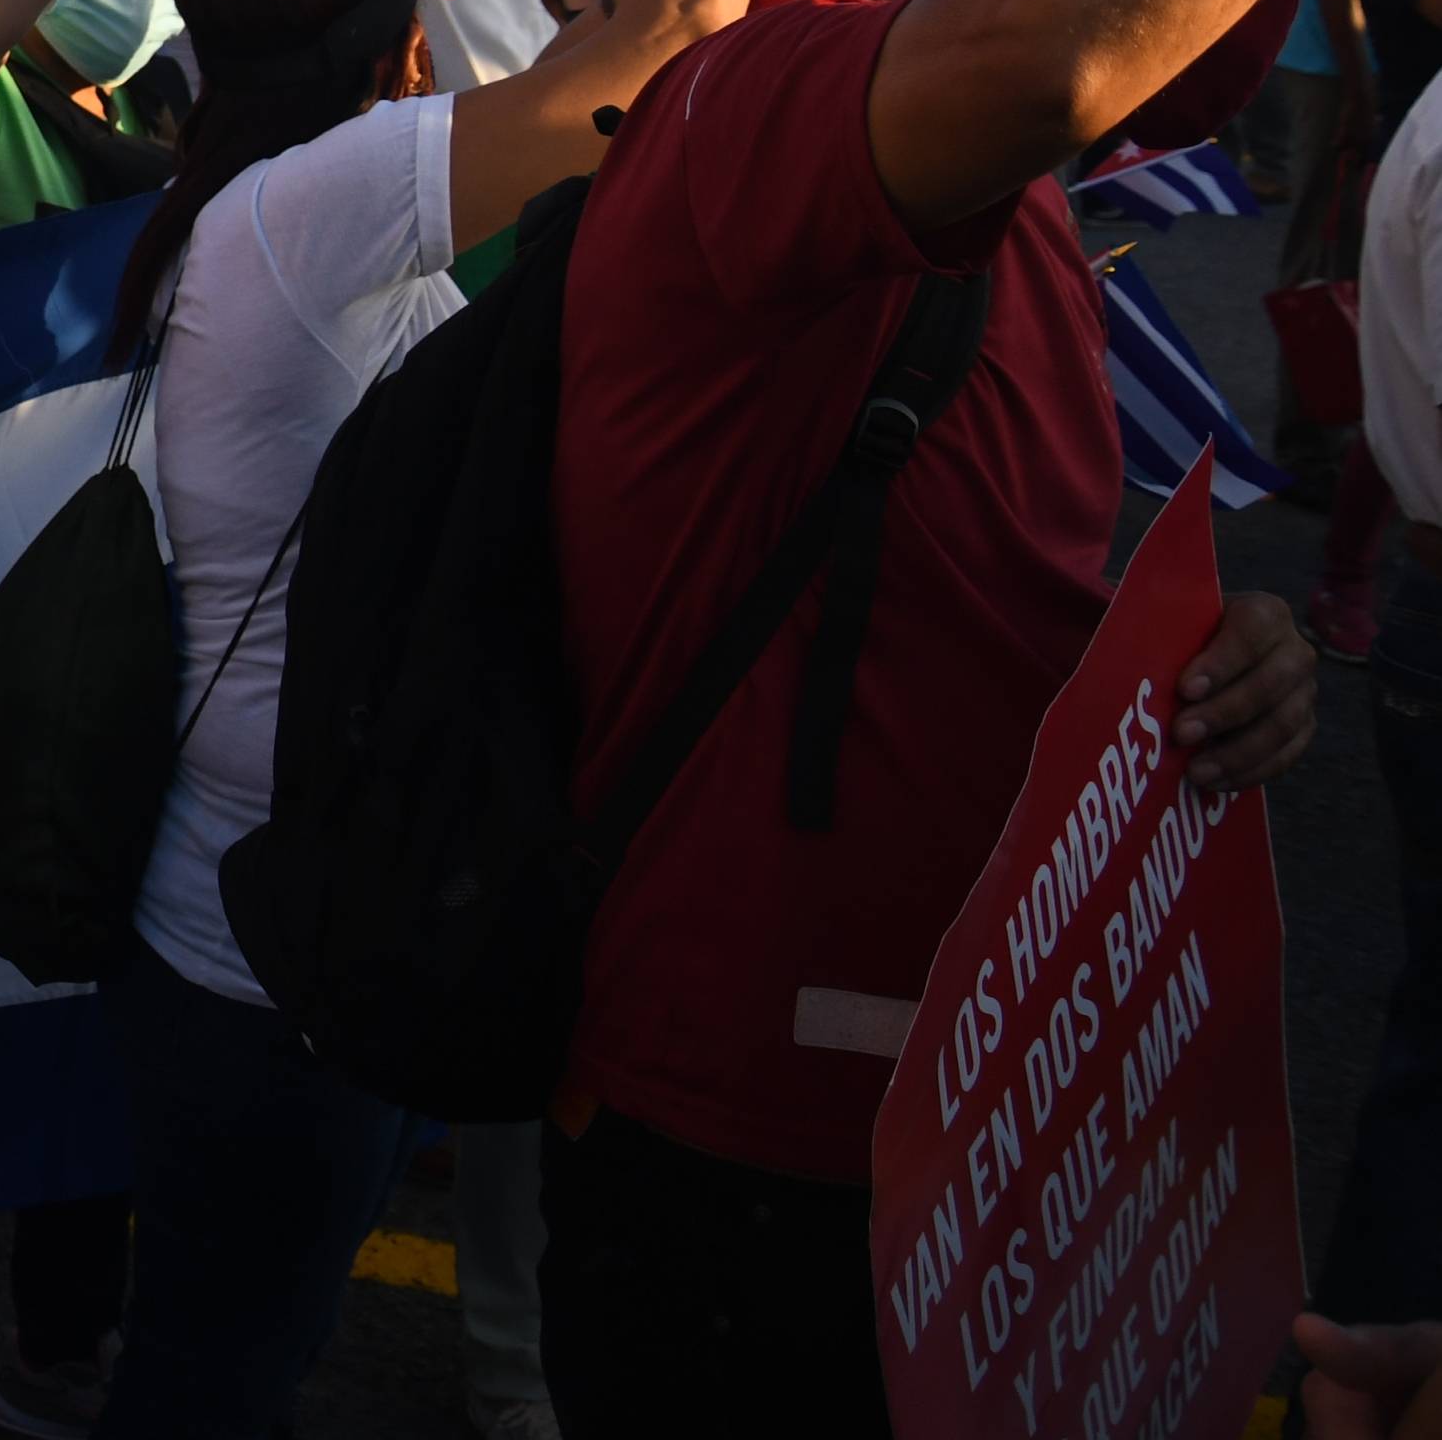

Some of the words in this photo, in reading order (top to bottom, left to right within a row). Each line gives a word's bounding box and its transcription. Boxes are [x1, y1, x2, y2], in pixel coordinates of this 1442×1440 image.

[937, 957, 1004, 1134] LOS
[1005, 677, 1162, 1006] HOMBRES
[890, 1181, 964, 1355] VAN
[967, 1086, 1023, 1229] EN
[1024, 961, 1100, 1135] DOS
[960, 1227, 1035, 1392] LOS
[1040, 1092, 1116, 1260] QUE
[1124, 928, 1211, 1143] AMAN
[1013, 1349, 1037, 1438] Y
[1048, 1115, 1186, 1393] FUNDAN,
[1150, 1124, 1238, 1337] ODIAN
